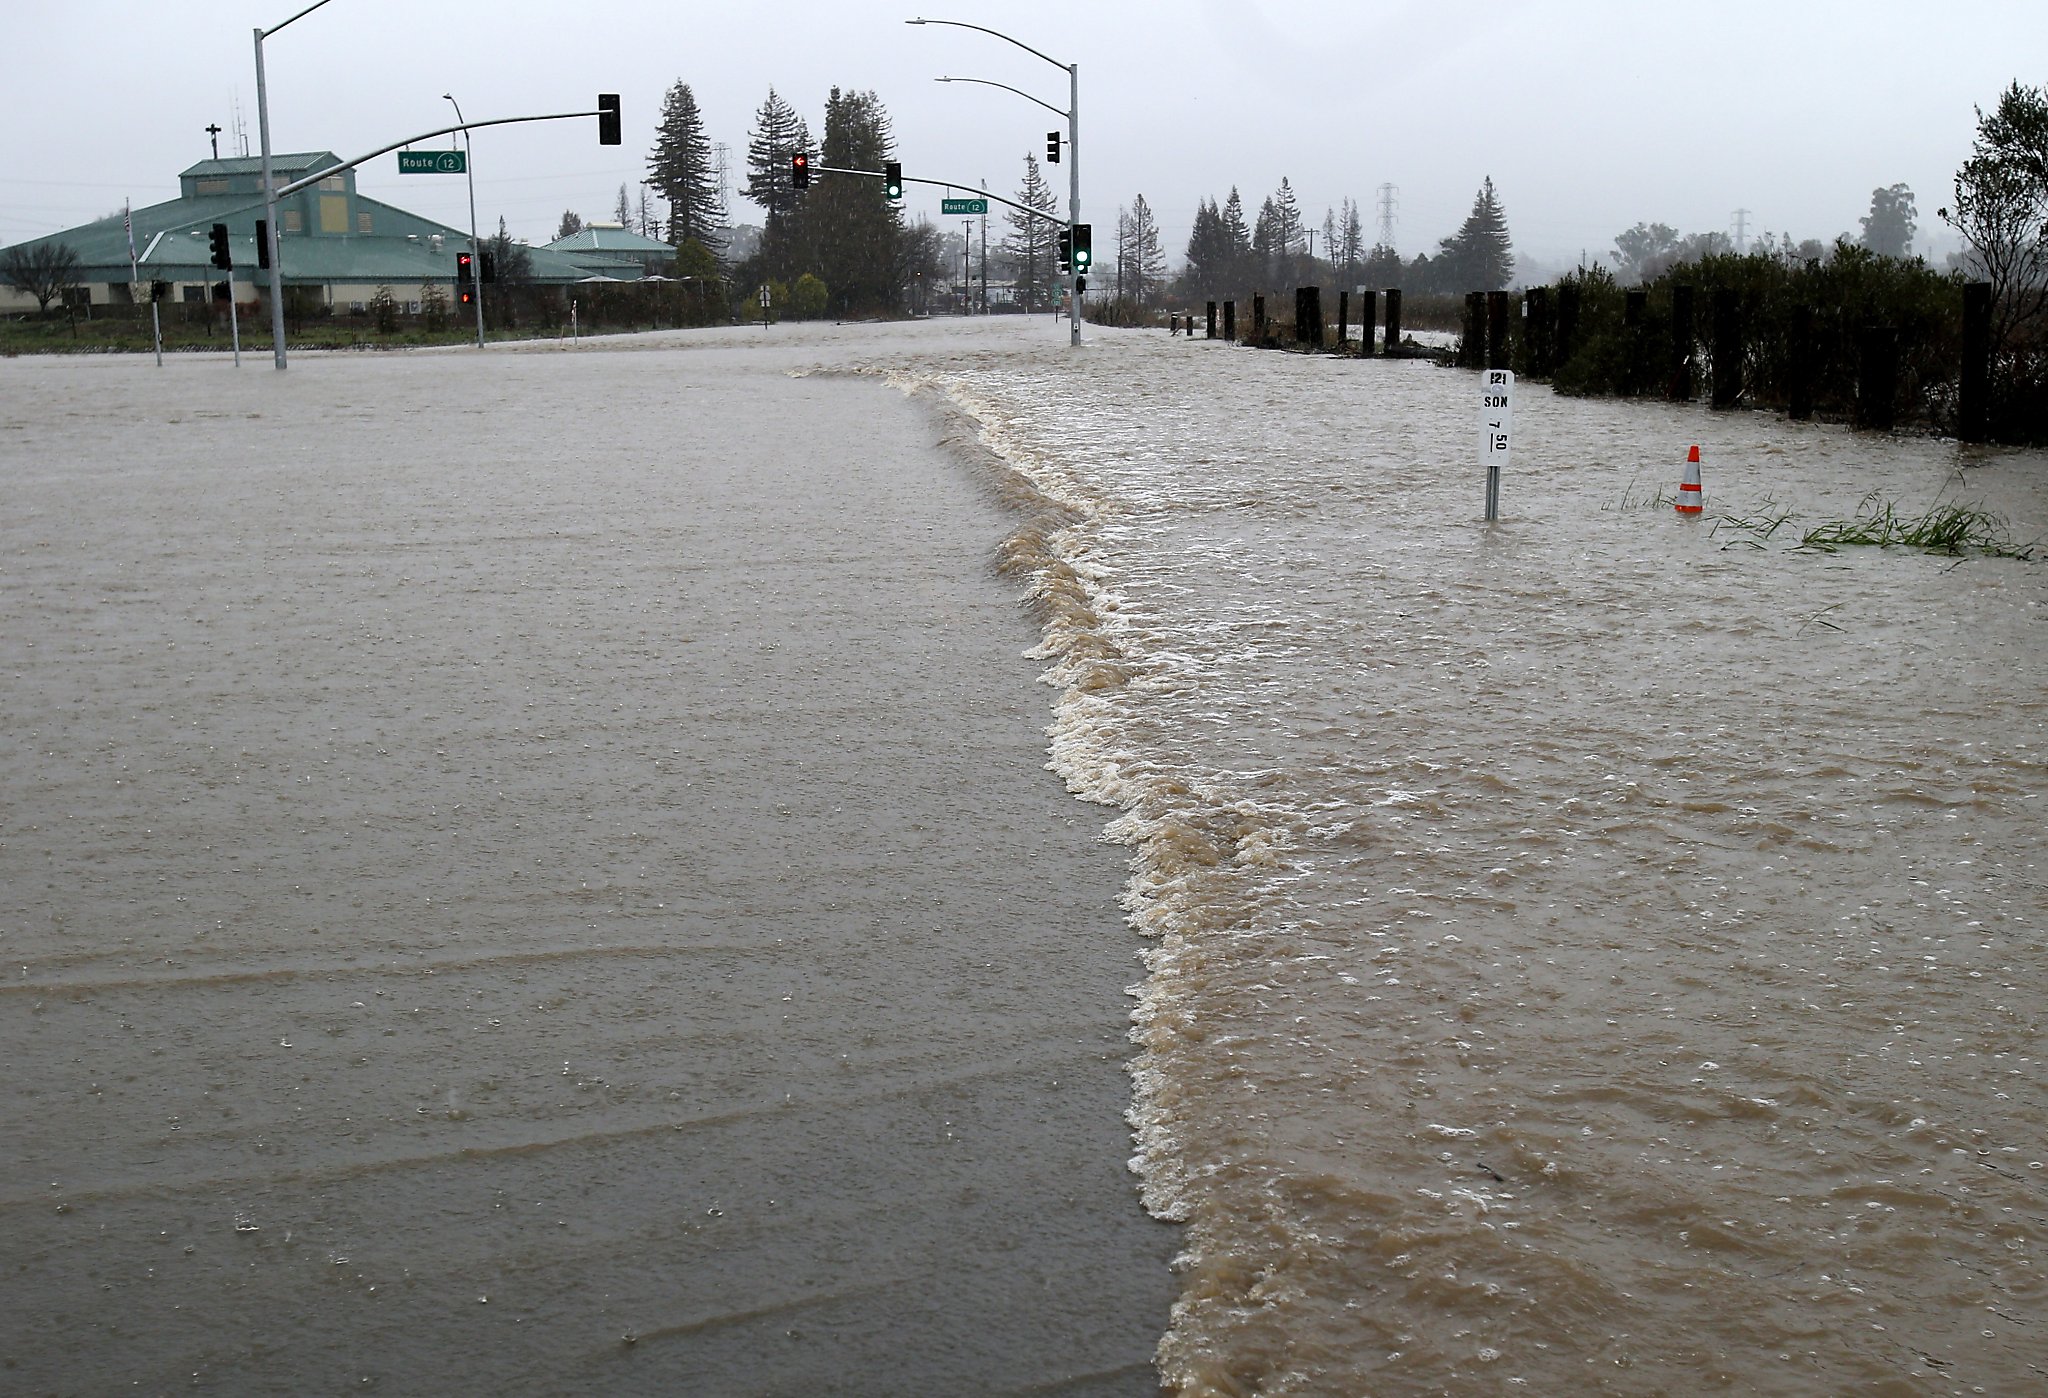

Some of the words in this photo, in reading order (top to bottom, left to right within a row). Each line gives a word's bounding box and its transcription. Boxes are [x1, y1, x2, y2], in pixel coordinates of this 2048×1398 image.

[403, 158, 433, 167] Route
[443, 159, 455, 168] 12
[1490, 372, 1507, 385] 121
[1484, 396, 1508, 407] SON
[1495, 434, 1508, 450] 50
